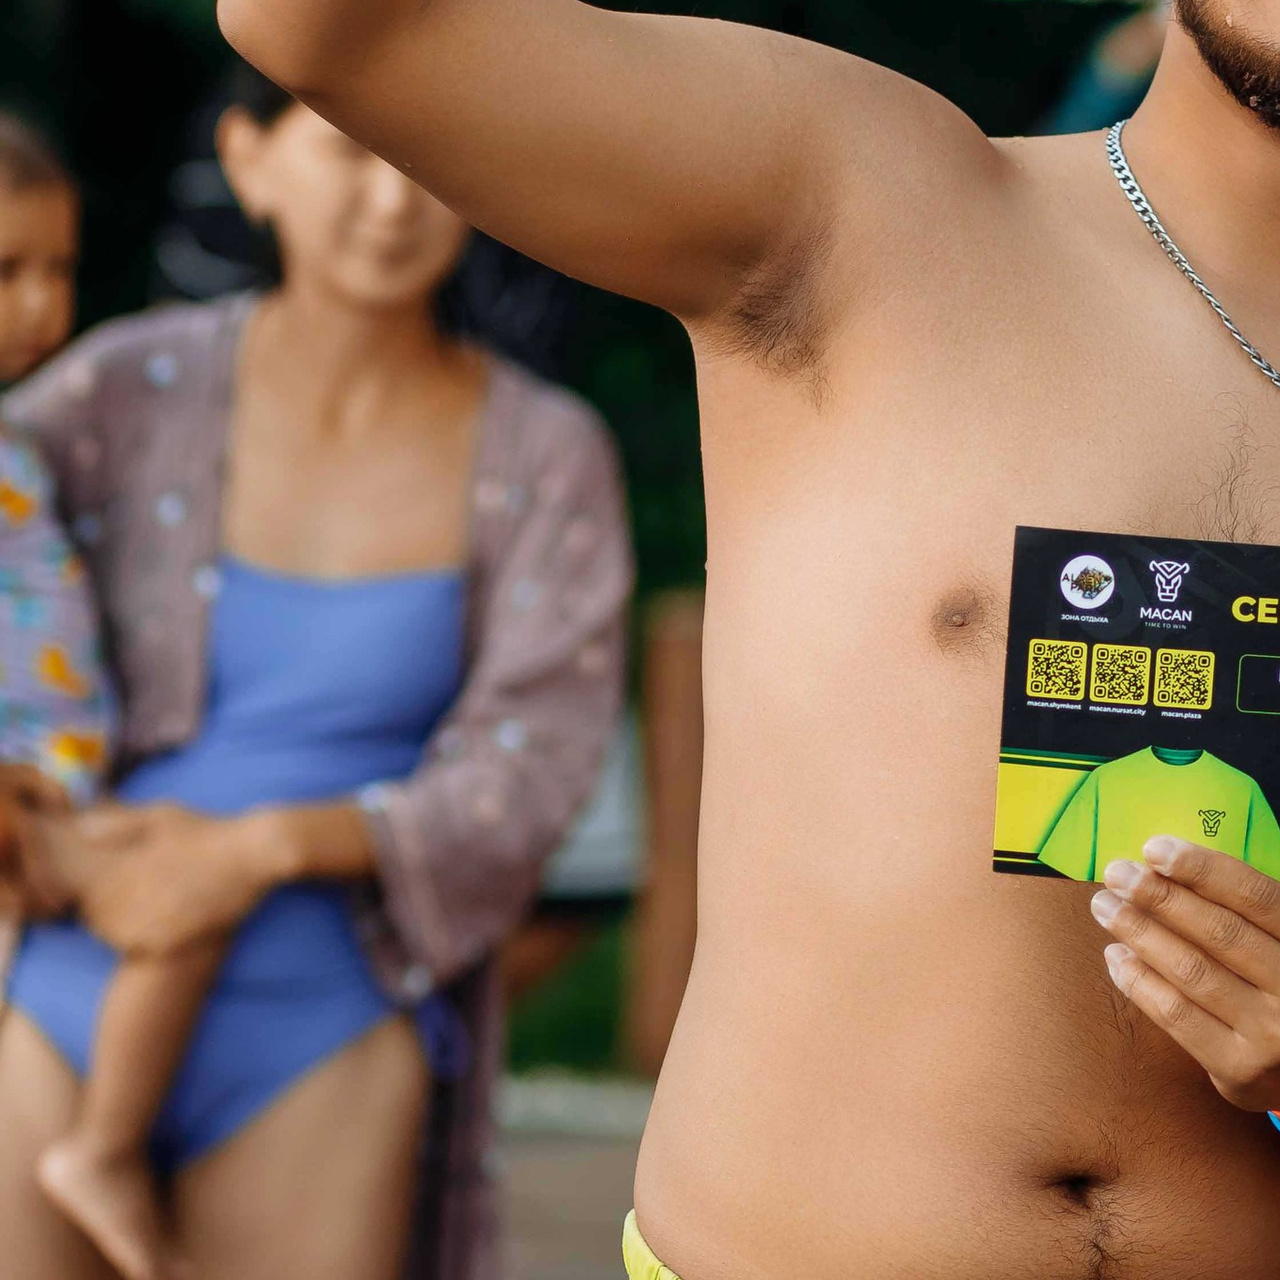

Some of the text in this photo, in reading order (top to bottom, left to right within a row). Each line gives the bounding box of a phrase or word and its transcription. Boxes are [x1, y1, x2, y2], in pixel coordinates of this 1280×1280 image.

[1061, 613, 1109, 624] ЗОНА ОТДЫХА
[1139, 606, 1192, 622] MACAN
[1027, 699, 1082, 710] macan.shymkent
[1089, 705, 1146, 716] macan.nursat.city
[1161, 711, 1202, 720] macan.plaza
